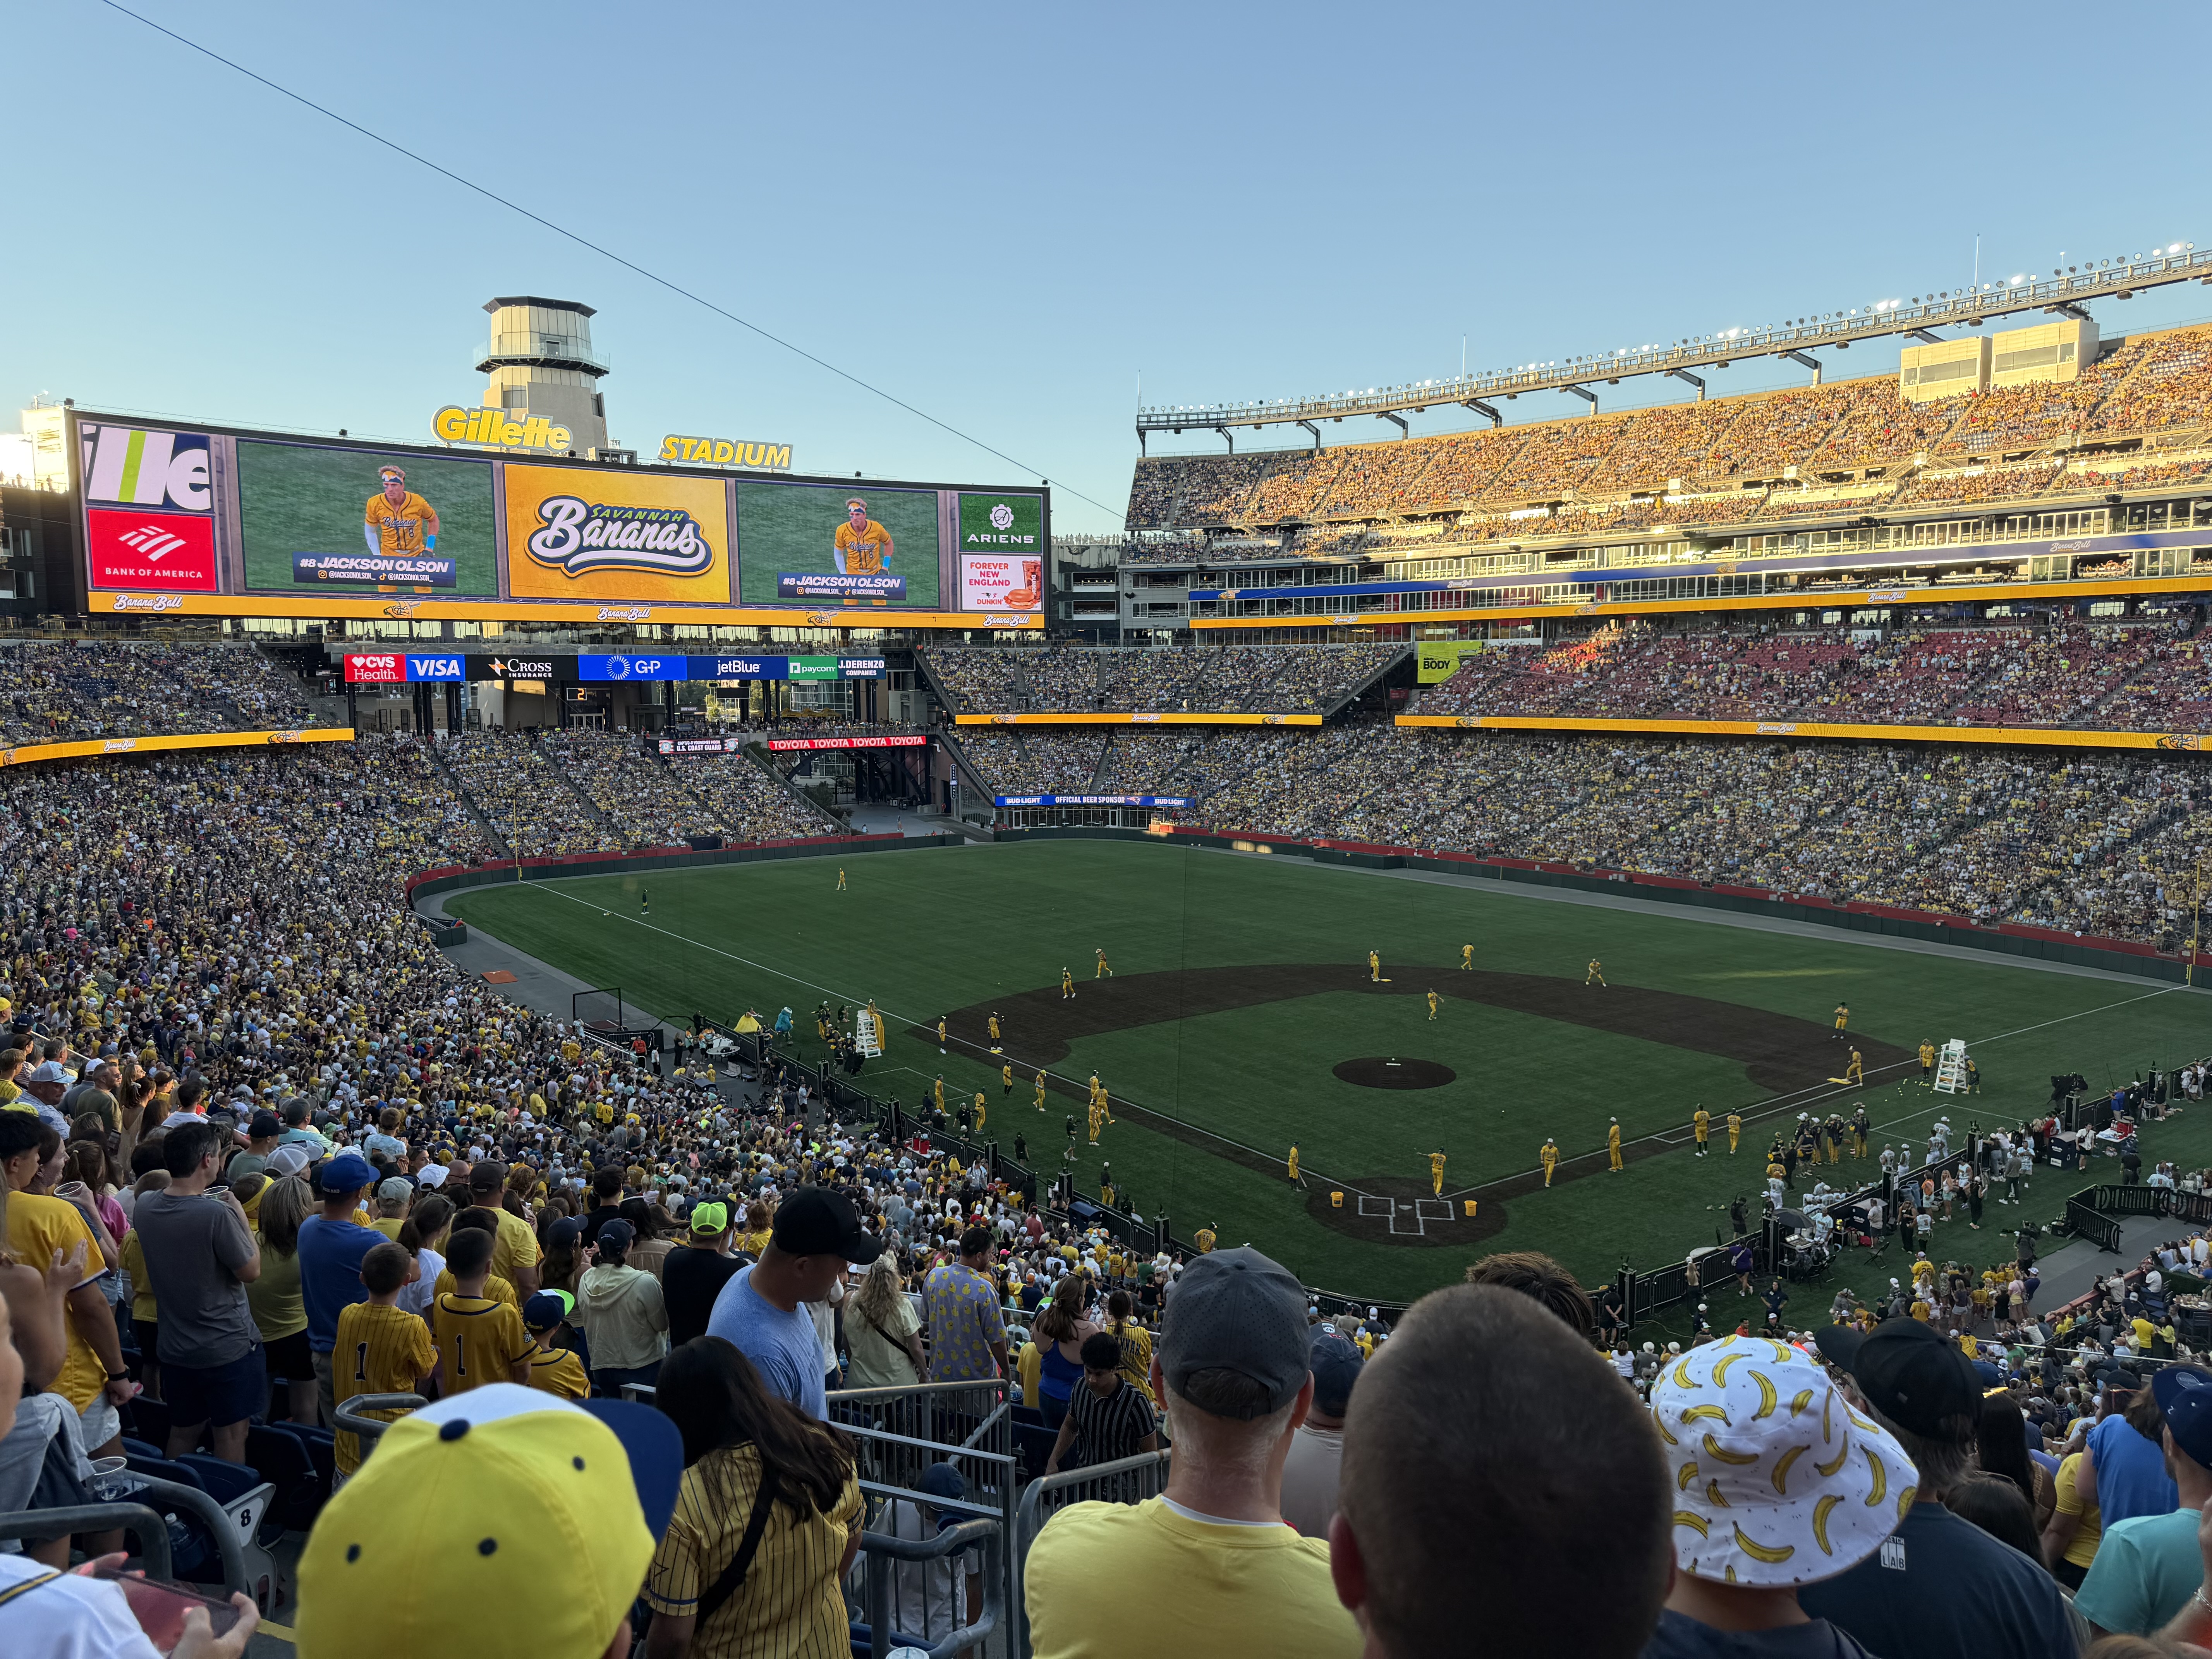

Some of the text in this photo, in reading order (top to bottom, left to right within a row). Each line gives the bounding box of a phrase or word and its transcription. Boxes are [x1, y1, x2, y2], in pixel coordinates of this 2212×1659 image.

[437, 409, 570, 450] Gillette
[663, 437, 790, 467] STADIUM
[591, 507, 684, 522] SAVANNAH
[408, 527, 414, 538] 8
[531, 499, 706, 567] Bananas
[968, 534, 1034, 544] ARIENS
[2050, 540, 2091, 552] Banana Ball
[300, 557, 449, 573] #8 JACKSON OLSON
[106, 568, 135, 576] BANK
[155, 570, 203, 579] AMERICA
[797, 576, 857, 587] JACKSON
[858, 577, 900, 588] OLSON
[113, 595, 182, 611] Banana Ball
[1867, 591, 1906, 603] Banana Ball
[597, 608, 651, 621] Banana Ball
[983, 615, 1030, 627] Banana Ball
[366, 656, 395, 668] CVS
[410, 659, 460, 676] VISA
[717, 660, 760, 675] jetBlue
[1423, 660, 1450, 669] BODY
[577, 688, 584, 700] 2
[1755, 723, 1796, 734] Banana Ball
[773, 737, 923, 749] TOYOTA TOYOTA TOYOTA TOYOTA
[1922, 1267, 1931, 1276] 25
[456, 1334, 466, 1376] 1
[355, 1342, 368, 1382] 1
[240, 1509, 251, 1527] 8
[1888, 1536, 1905, 1546] ETCH
[1883, 1557, 1905, 1569] LAB
